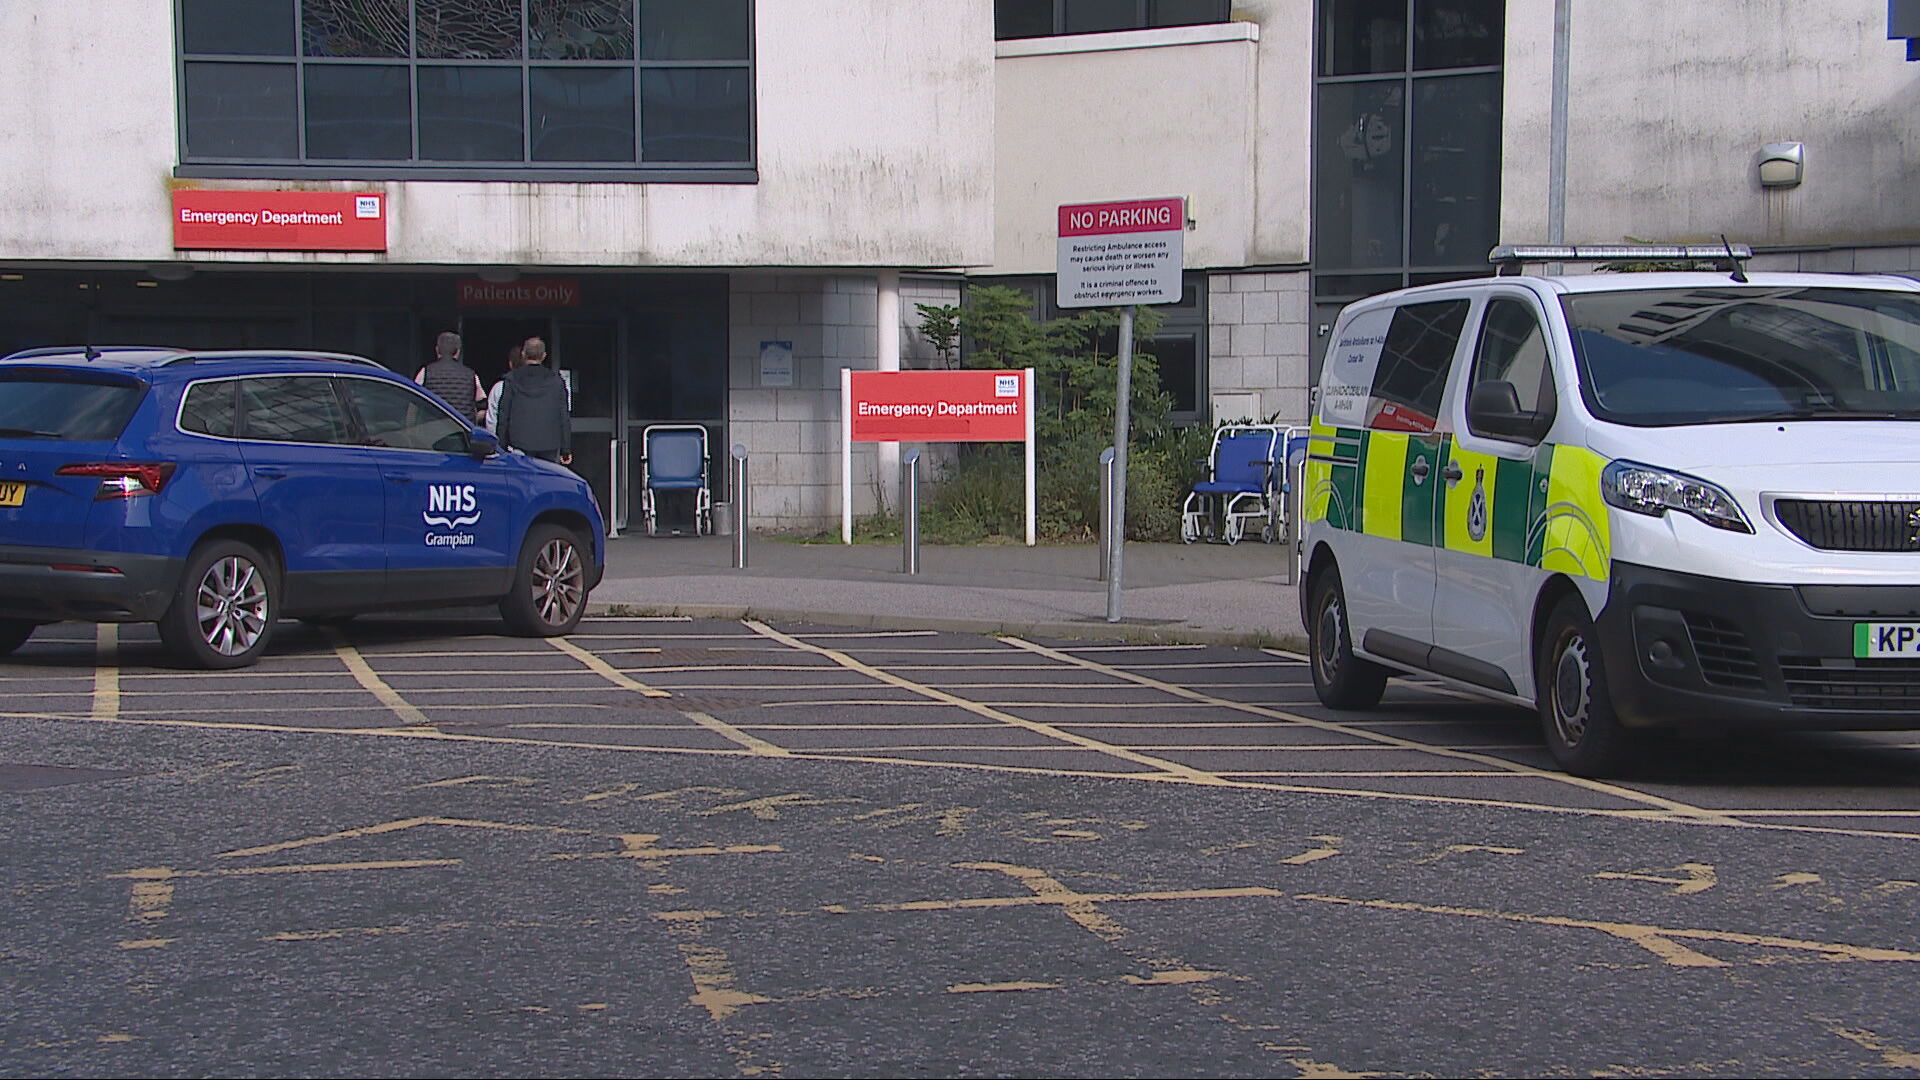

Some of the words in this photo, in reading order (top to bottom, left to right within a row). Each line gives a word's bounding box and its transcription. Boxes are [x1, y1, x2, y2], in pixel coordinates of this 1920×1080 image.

[181, 209, 258, 225] Emergency
[261, 210, 343, 226] Department
[1070, 211, 1094, 230] NO
[1098, 206, 1171, 228] PARKING
[1073, 244, 1106, 253] Restricting
[1107, 242, 1143, 251] Ambulance
[1144, 241, 1167, 249] access
[1070, 255, 1083, 263] may
[1084, 255, 1103, 263] cause
[1104, 253, 1123, 261] death
[1132, 252, 1156, 260] worsen
[1157, 252, 1169, 260] any
[1107, 263, 1124, 271] injury
[1099, 279, 1124, 288] criminal
[1125, 278, 1149, 287] offence
[463, 285, 531, 301] Patients
[535, 285, 573, 304] Only
[1074, 291, 1100, 300] obstruct
[1136, 288, 1164, 297] workers.
[858, 401, 934, 418] Emergency
[937, 401, 1018, 417] Department
[429, 485, 477, 512] NHS
[425, 532, 474, 550] Grampian
[1878, 626, 1920, 652] KP
